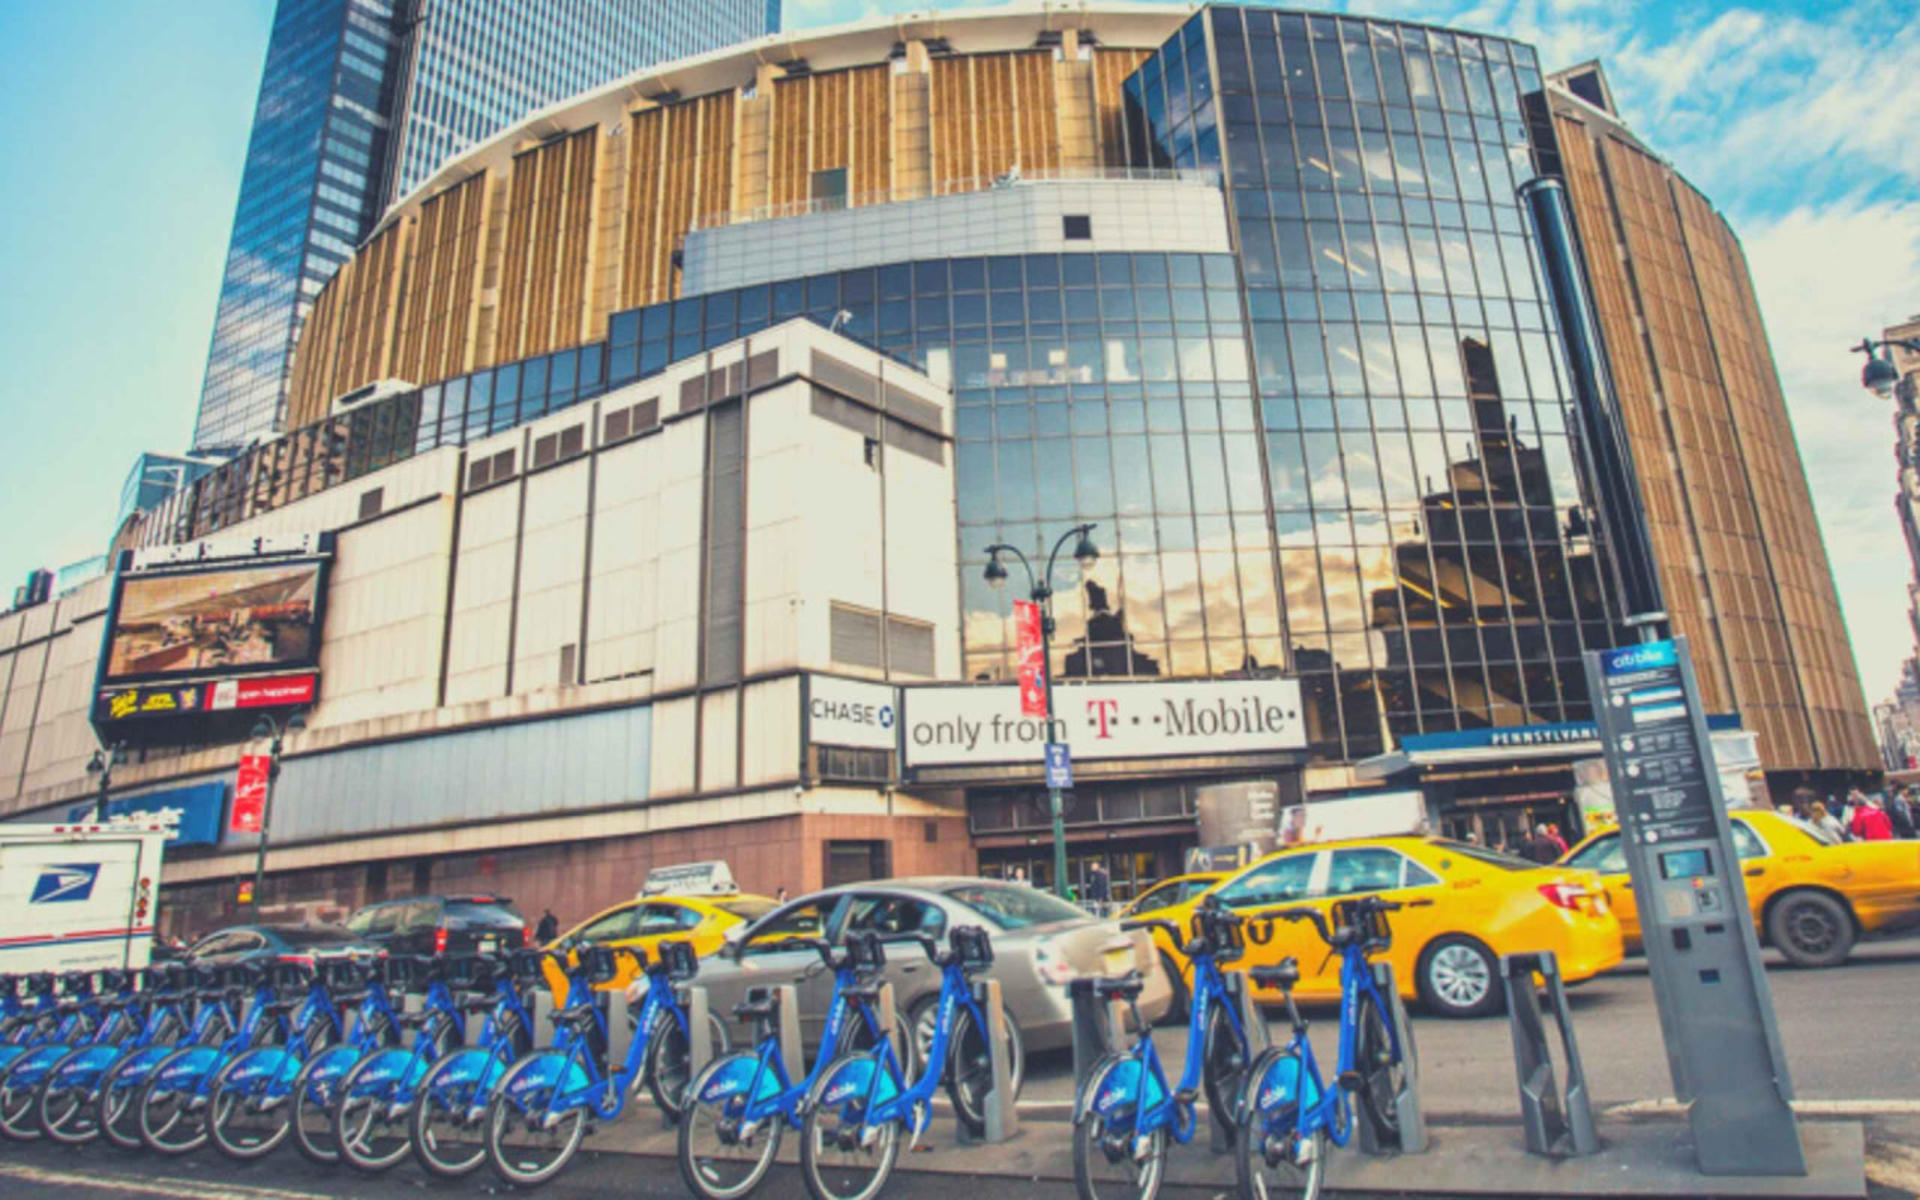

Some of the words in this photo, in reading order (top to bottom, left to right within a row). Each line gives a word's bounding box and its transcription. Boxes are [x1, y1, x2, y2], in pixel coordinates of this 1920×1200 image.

[811, 698, 876, 726] CHASE
[913, 715, 981, 751] only
[991, 714, 1067, 742] from
